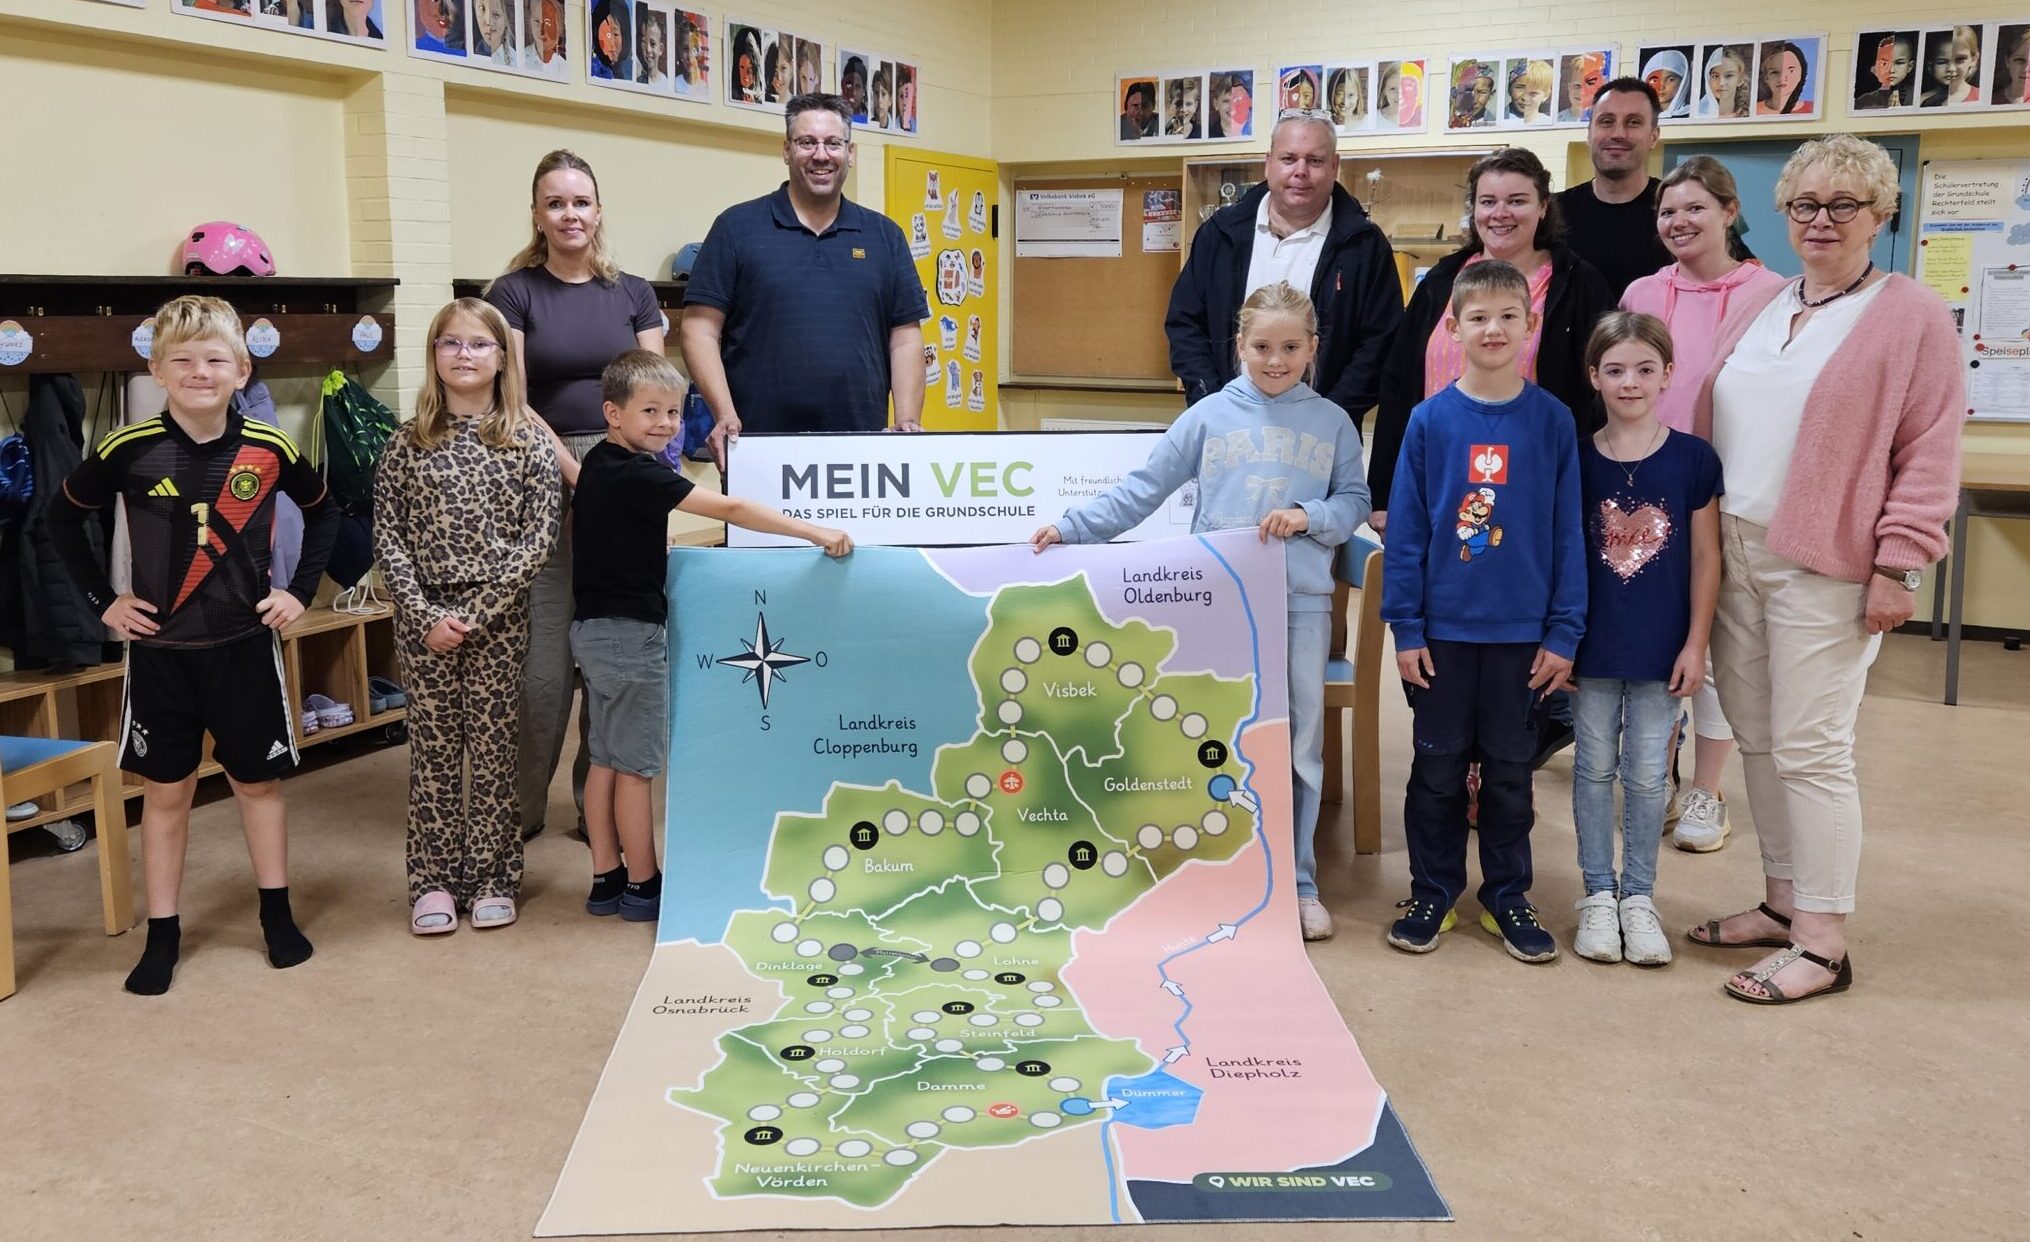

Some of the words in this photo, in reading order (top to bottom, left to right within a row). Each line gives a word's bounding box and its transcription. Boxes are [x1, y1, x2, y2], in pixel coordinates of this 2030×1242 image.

[1982, 346, 2030, 357] Speisepl
[1201, 426, 1336, 480] PARIS
[782, 463, 910, 500] MEIN
[929, 461, 1035, 498] VEC
[1063, 476, 1078, 485] Mit
[782, 508, 812, 520] DAS
[816, 508, 858, 519] SPIEL
[862, 505, 891, 518] FÜR
[896, 507, 921, 518] DIE
[925, 505, 1036, 518] GRUNDSCHULE
[191, 502, 209, 547] 1
[1123, 566, 1203, 583] Landkreis
[755, 589, 766, 605] N
[1124, 587, 1212, 606] Oldenburg
[697, 653, 714, 669] W
[815, 651, 828, 667] O
[1043, 681, 1097, 698] Visbek
[760, 715, 771, 731] S
[839, 714, 916, 731] Landkreis
[813, 738, 918, 758] Cloppenburg
[1104, 777, 1193, 792] Goldenstedt
[1017, 808, 1069, 823] Vechta
[865, 858, 914, 873] Bakum
[756, 962, 823, 972] Dinklage
[994, 957, 1040, 966] Lohne
[664, 995, 752, 1005] Landkreis
[653, 1005, 750, 1015] Osnabrück
[959, 1029, 1037, 1039] Steinfeld
[820, 1046, 886, 1056] Holdorf
[1206, 1056, 1302, 1067] Landkreis
[1209, 1068, 1301, 1080] Diepholz
[917, 1081, 986, 1091] Damme
[1122, 1088, 1186, 1097] Dümmer
[735, 1161, 881, 1174] Neuenkirchen-
[757, 1175, 828, 1187] Vörden
[1228, 1176, 1272, 1187] WIR
[1276, 1176, 1327, 1187] SIND
[1330, 1176, 1376, 1187] VEC
